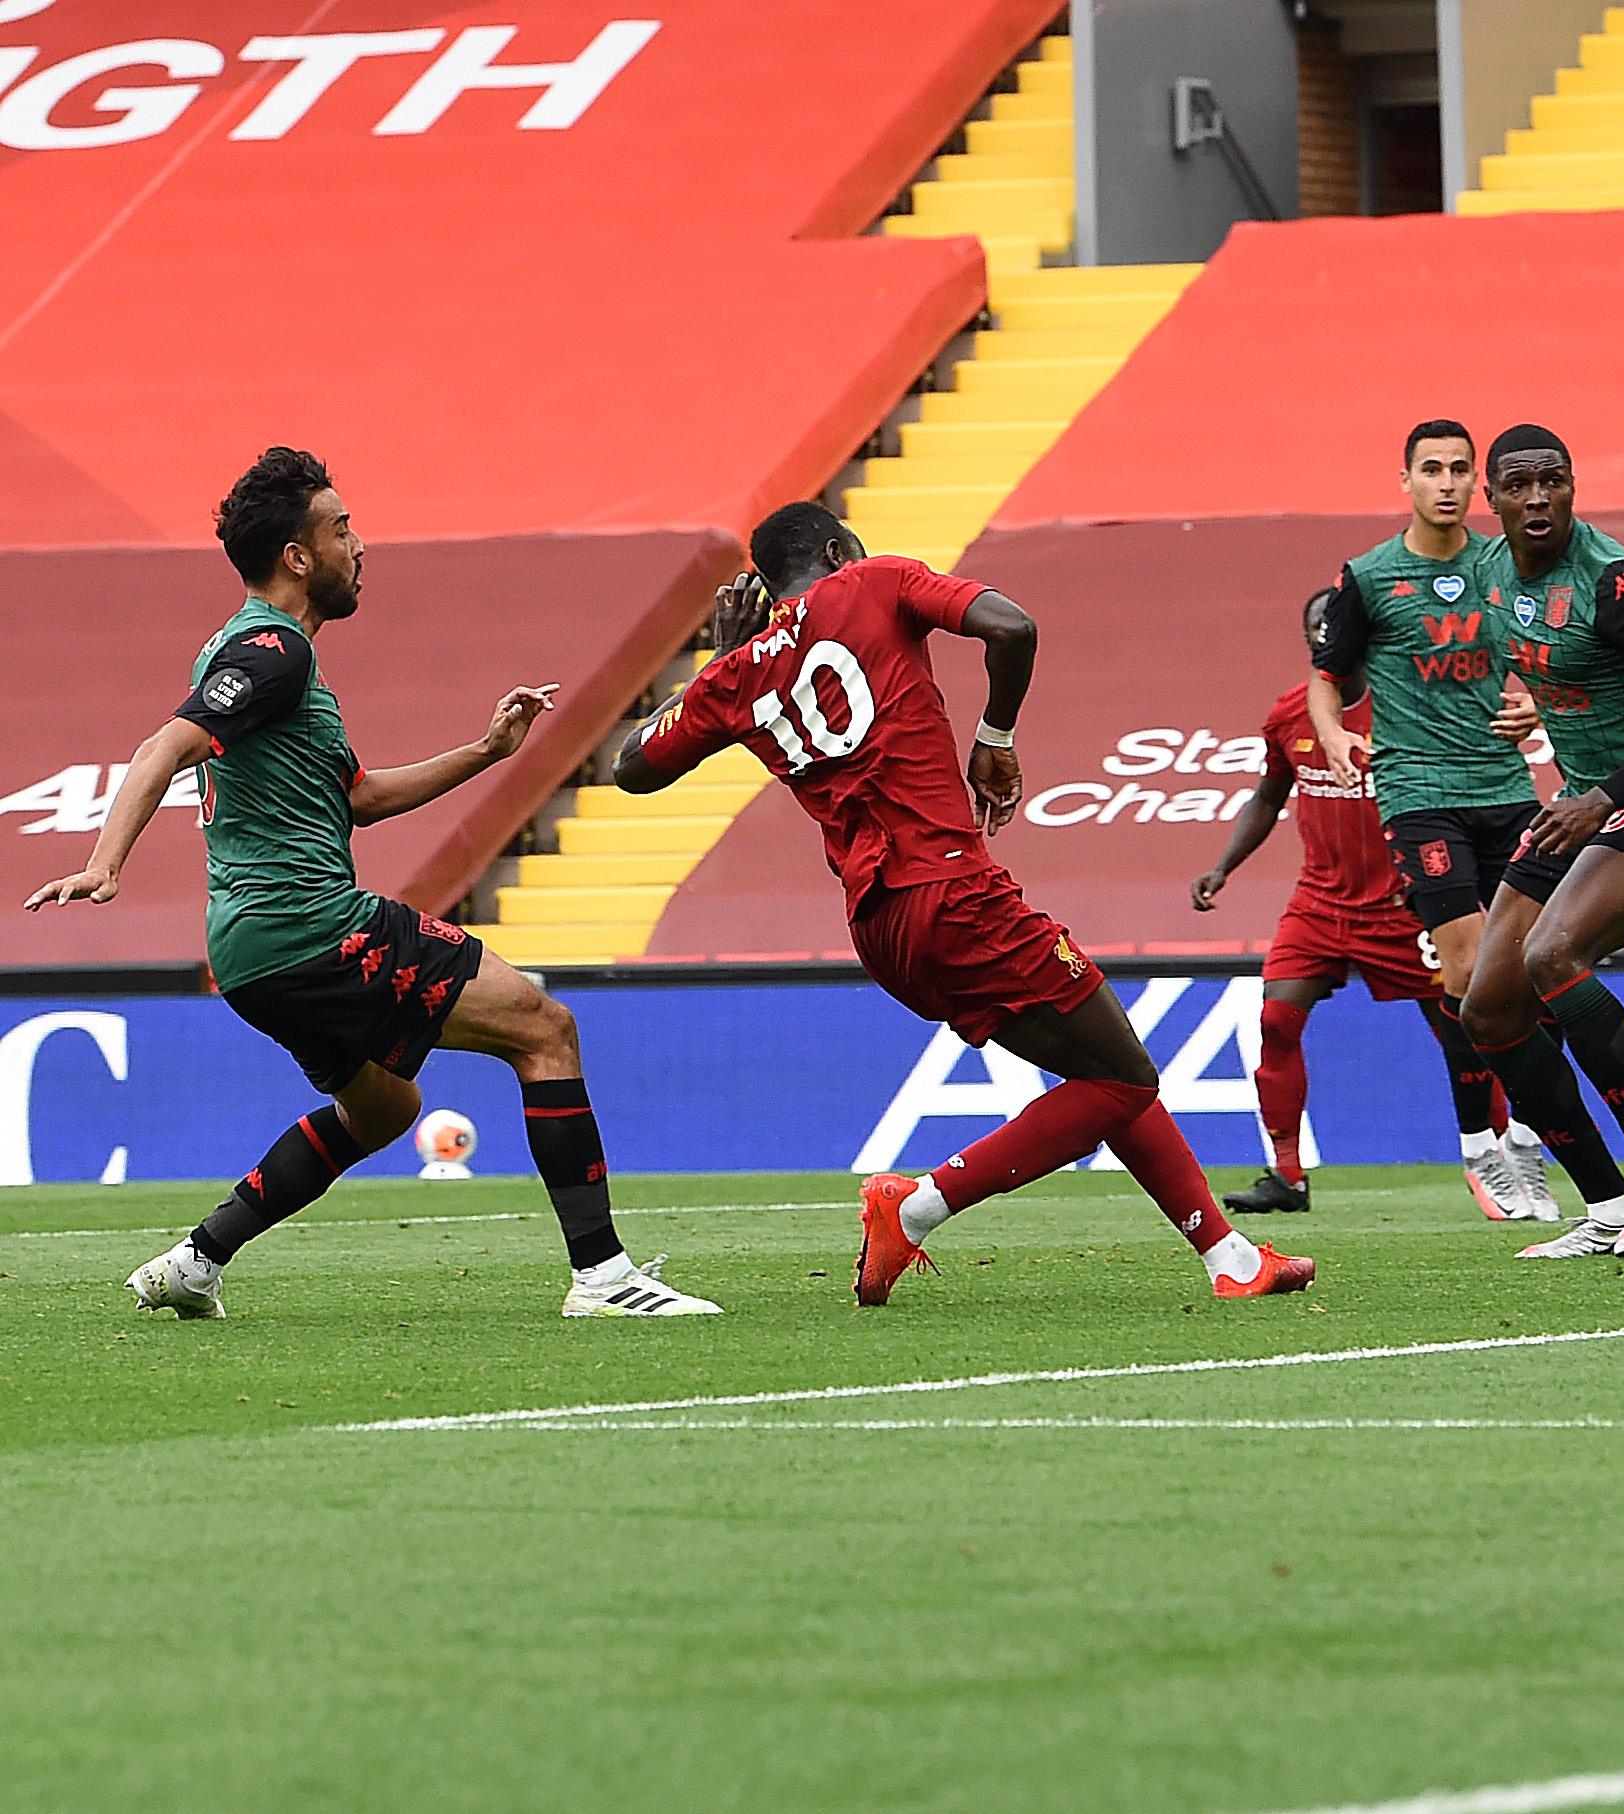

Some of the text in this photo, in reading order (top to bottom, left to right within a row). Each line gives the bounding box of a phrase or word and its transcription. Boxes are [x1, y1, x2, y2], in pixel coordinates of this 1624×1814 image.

[0, 20, 662, 150] GTH
[752, 640, 875, 775] 10
[1412, 650, 1490, 682] W88
